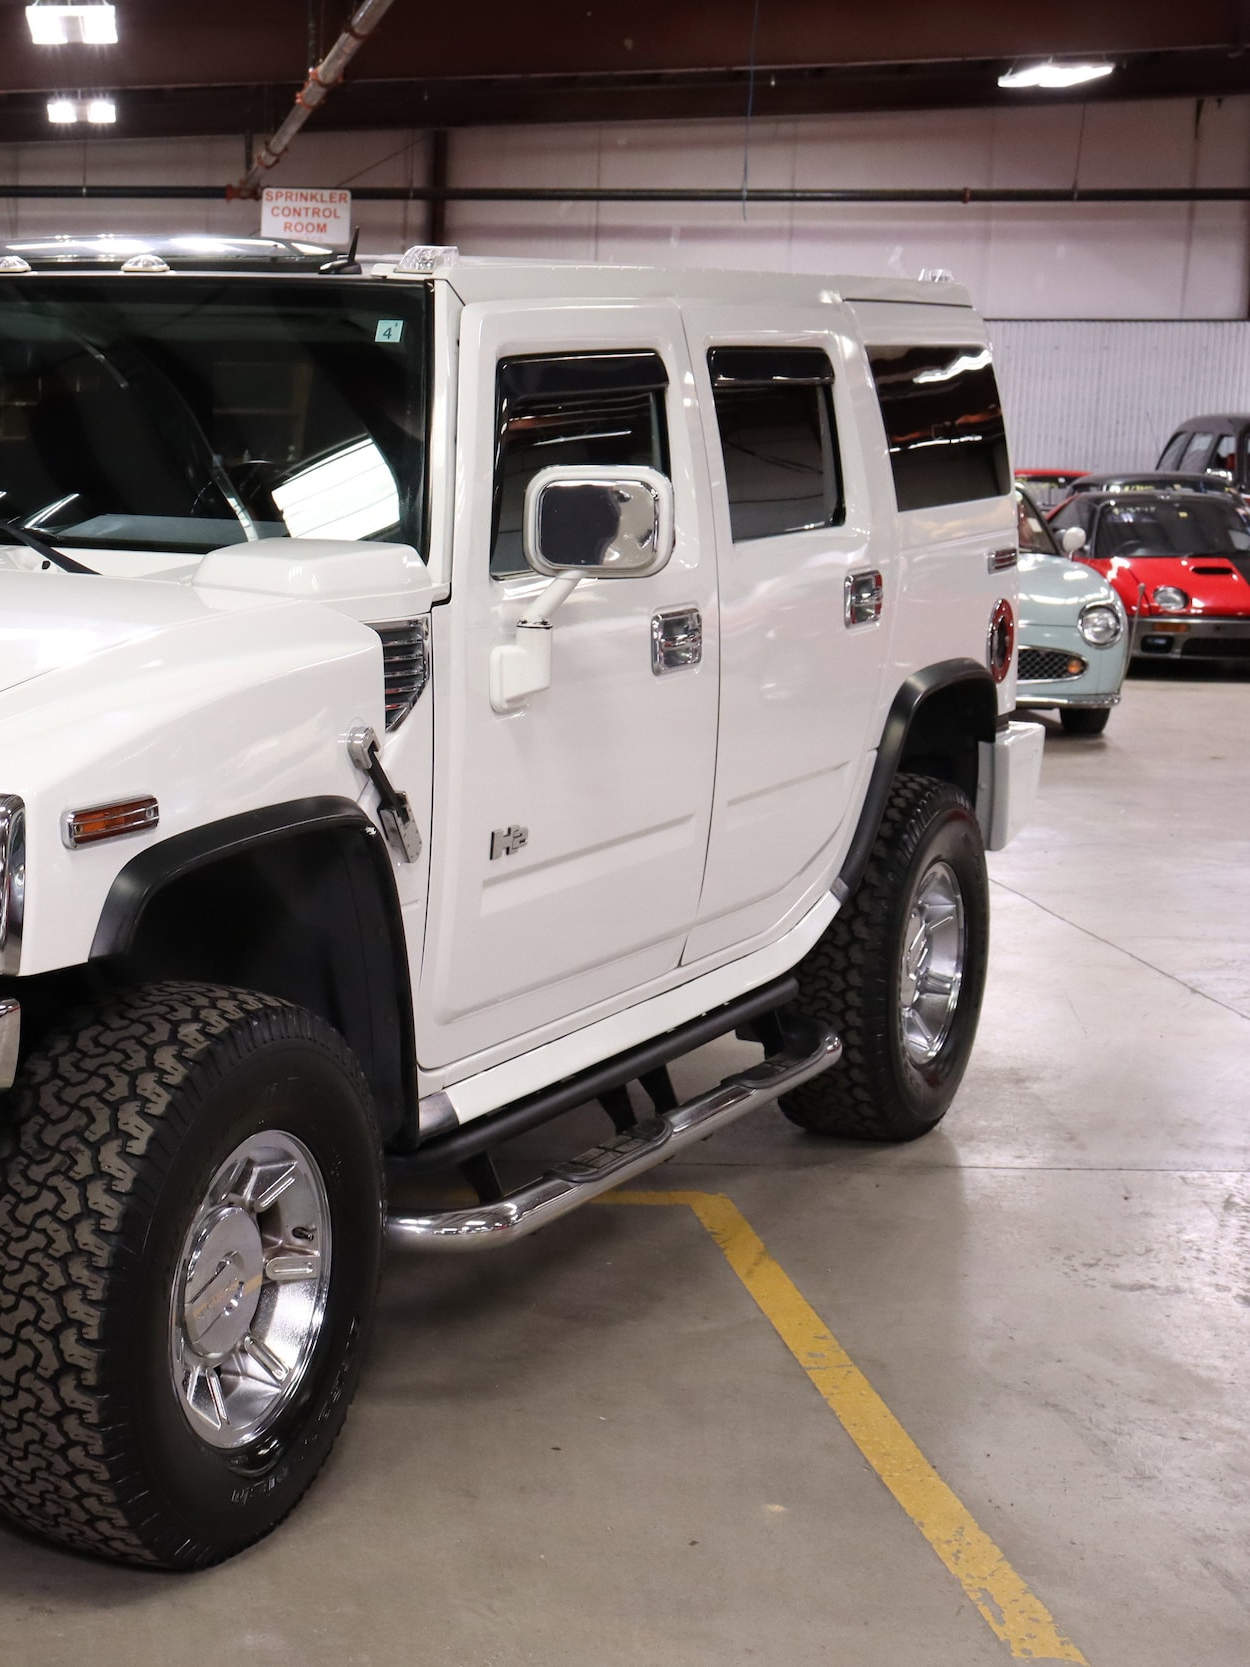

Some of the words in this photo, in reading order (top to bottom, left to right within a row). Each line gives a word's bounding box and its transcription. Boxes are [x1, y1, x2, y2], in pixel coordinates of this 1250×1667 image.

[265, 190, 348, 203] SPRINKLER
[271, 206, 341, 219] CONTROL
[283, 221, 328, 233] ROOM
[383, 327, 392, 340] 4
[490, 824, 529, 860] H2
